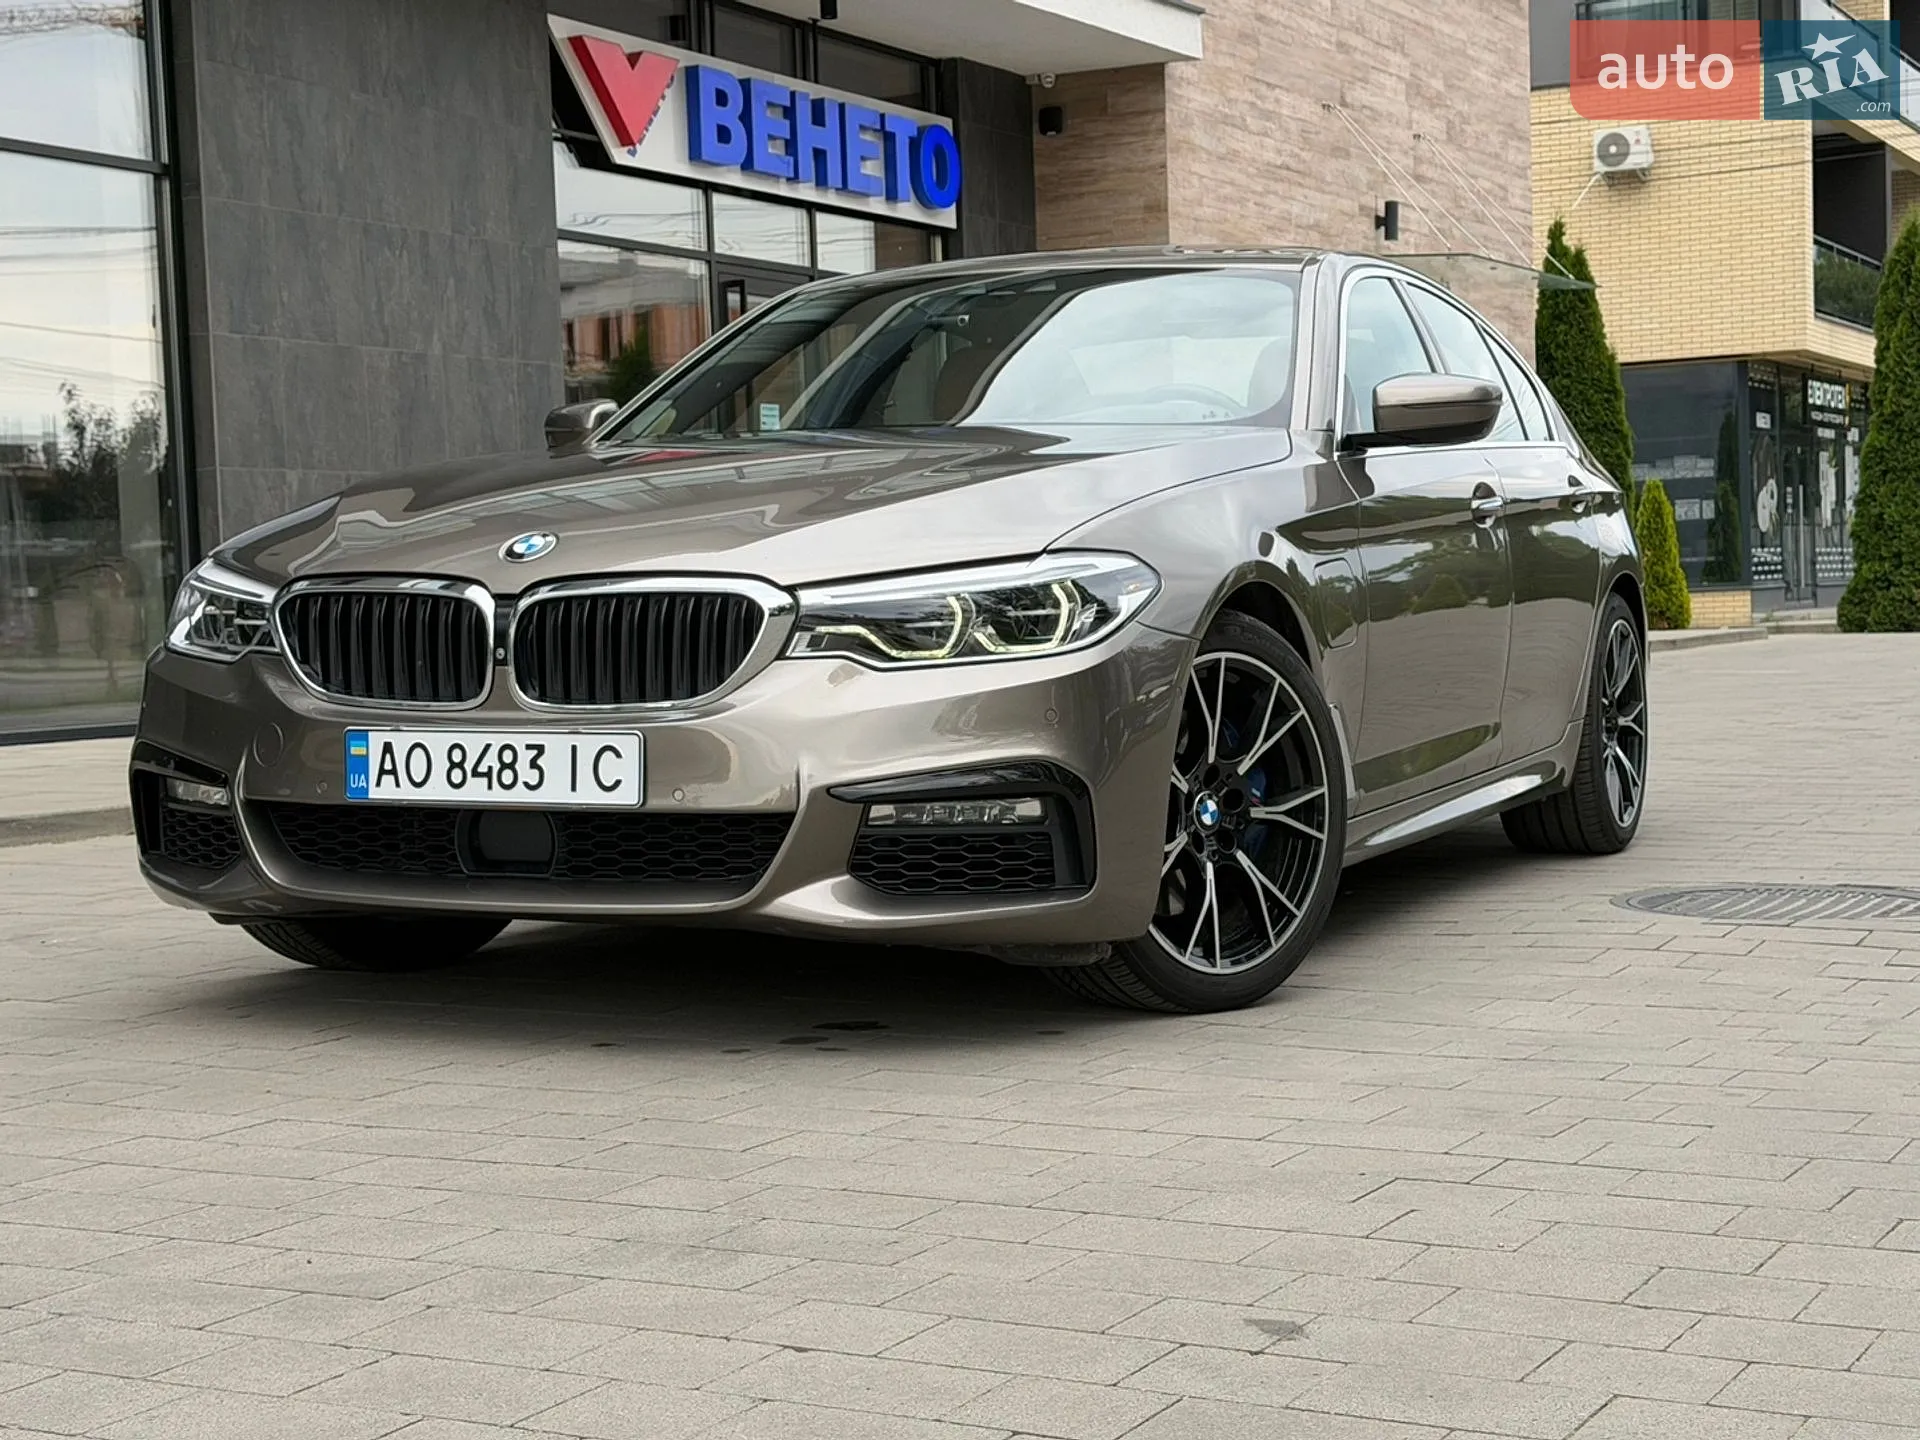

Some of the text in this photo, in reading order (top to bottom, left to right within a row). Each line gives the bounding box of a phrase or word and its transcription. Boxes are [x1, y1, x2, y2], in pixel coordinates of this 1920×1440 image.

[685, 64, 962, 209] ВЕНЕТО
[350, 774, 367, 789] UA
[375, 741, 433, 789] AO
[445, 742, 546, 791] 8483
